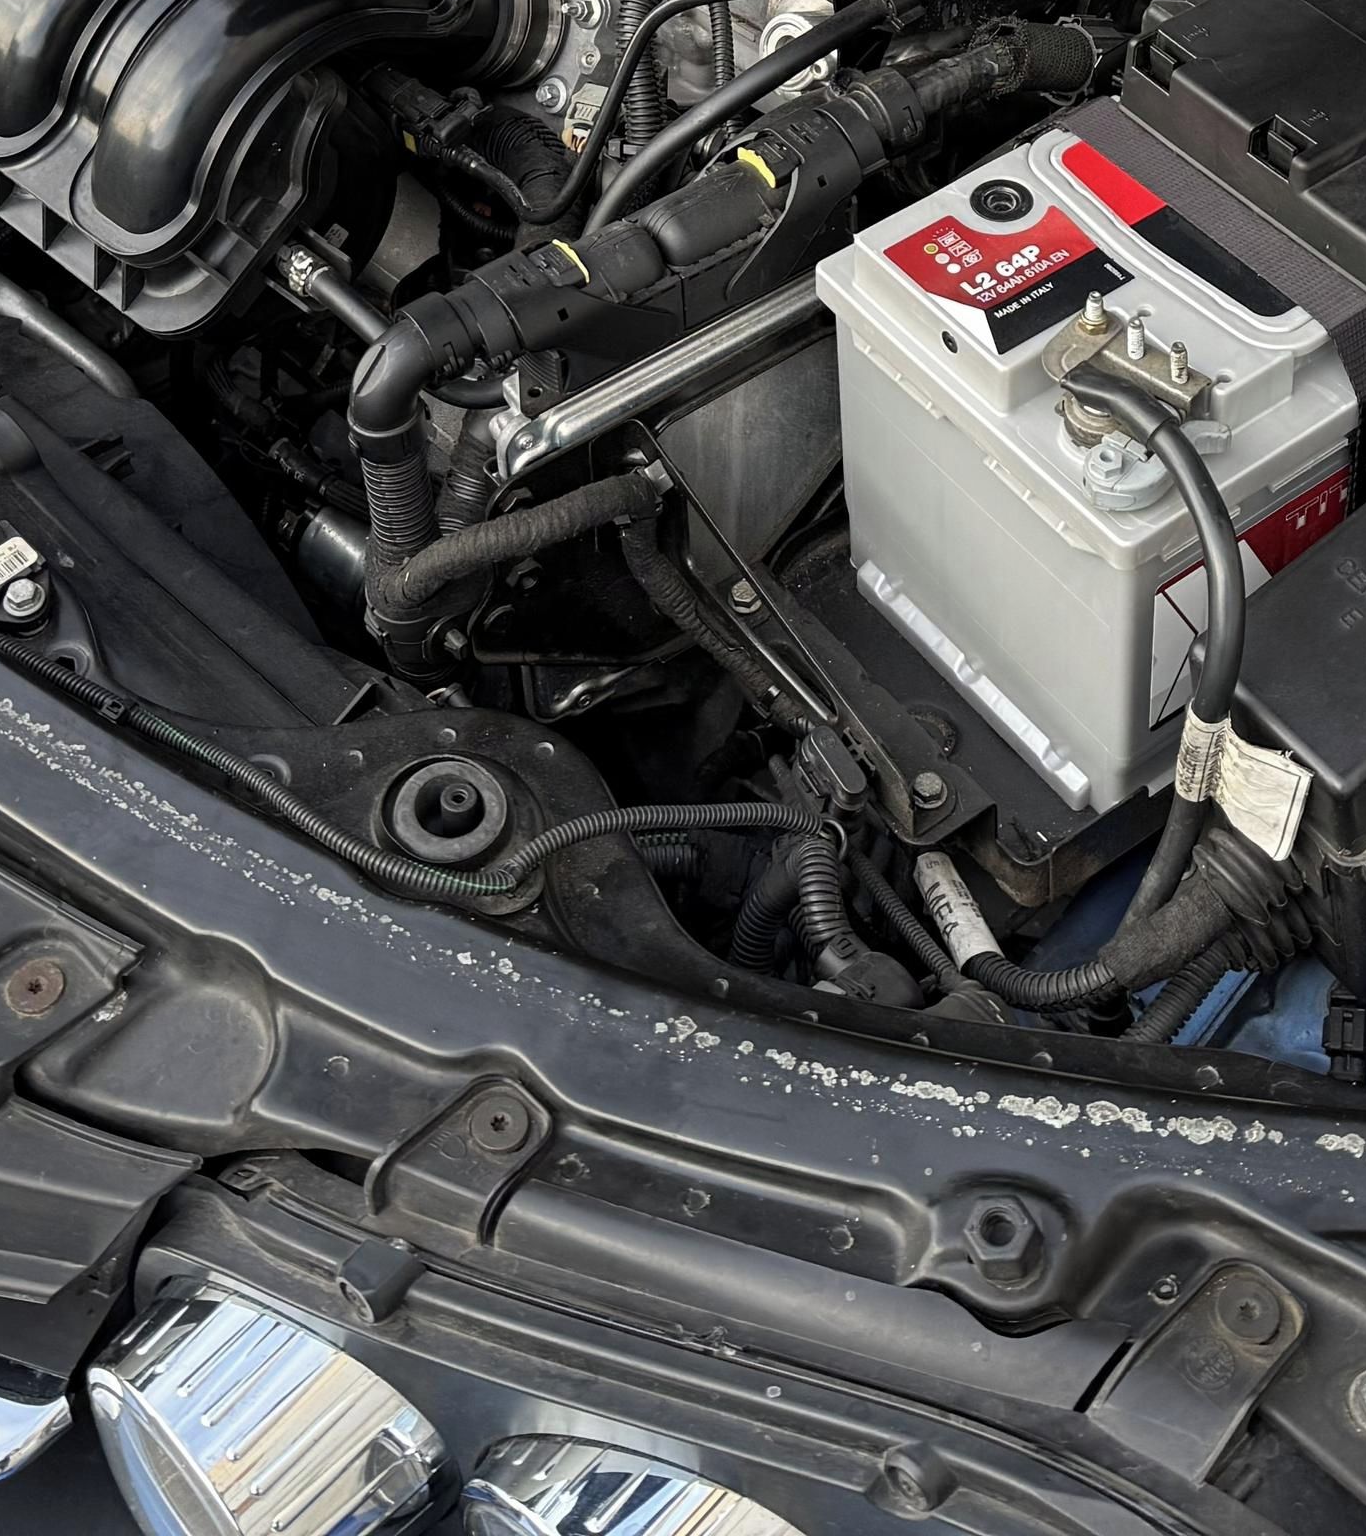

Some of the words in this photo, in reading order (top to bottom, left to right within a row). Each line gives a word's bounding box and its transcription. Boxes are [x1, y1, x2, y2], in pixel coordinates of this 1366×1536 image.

[959, 271, 998, 296] L2
[996, 245, 1041, 278] 64P
[975, 287, 998, 304] 12V
[997, 273, 1027, 294] 64Ah
[1025, 257, 1054, 279] 610A
[1052, 249, 1070, 263] EN
[993, 299, 1021, 319] MADE
[1020, 294, 1031, 304] IN
[1031, 281, 1055, 299] ITALY
[1339, 608, 1364, 631] E
